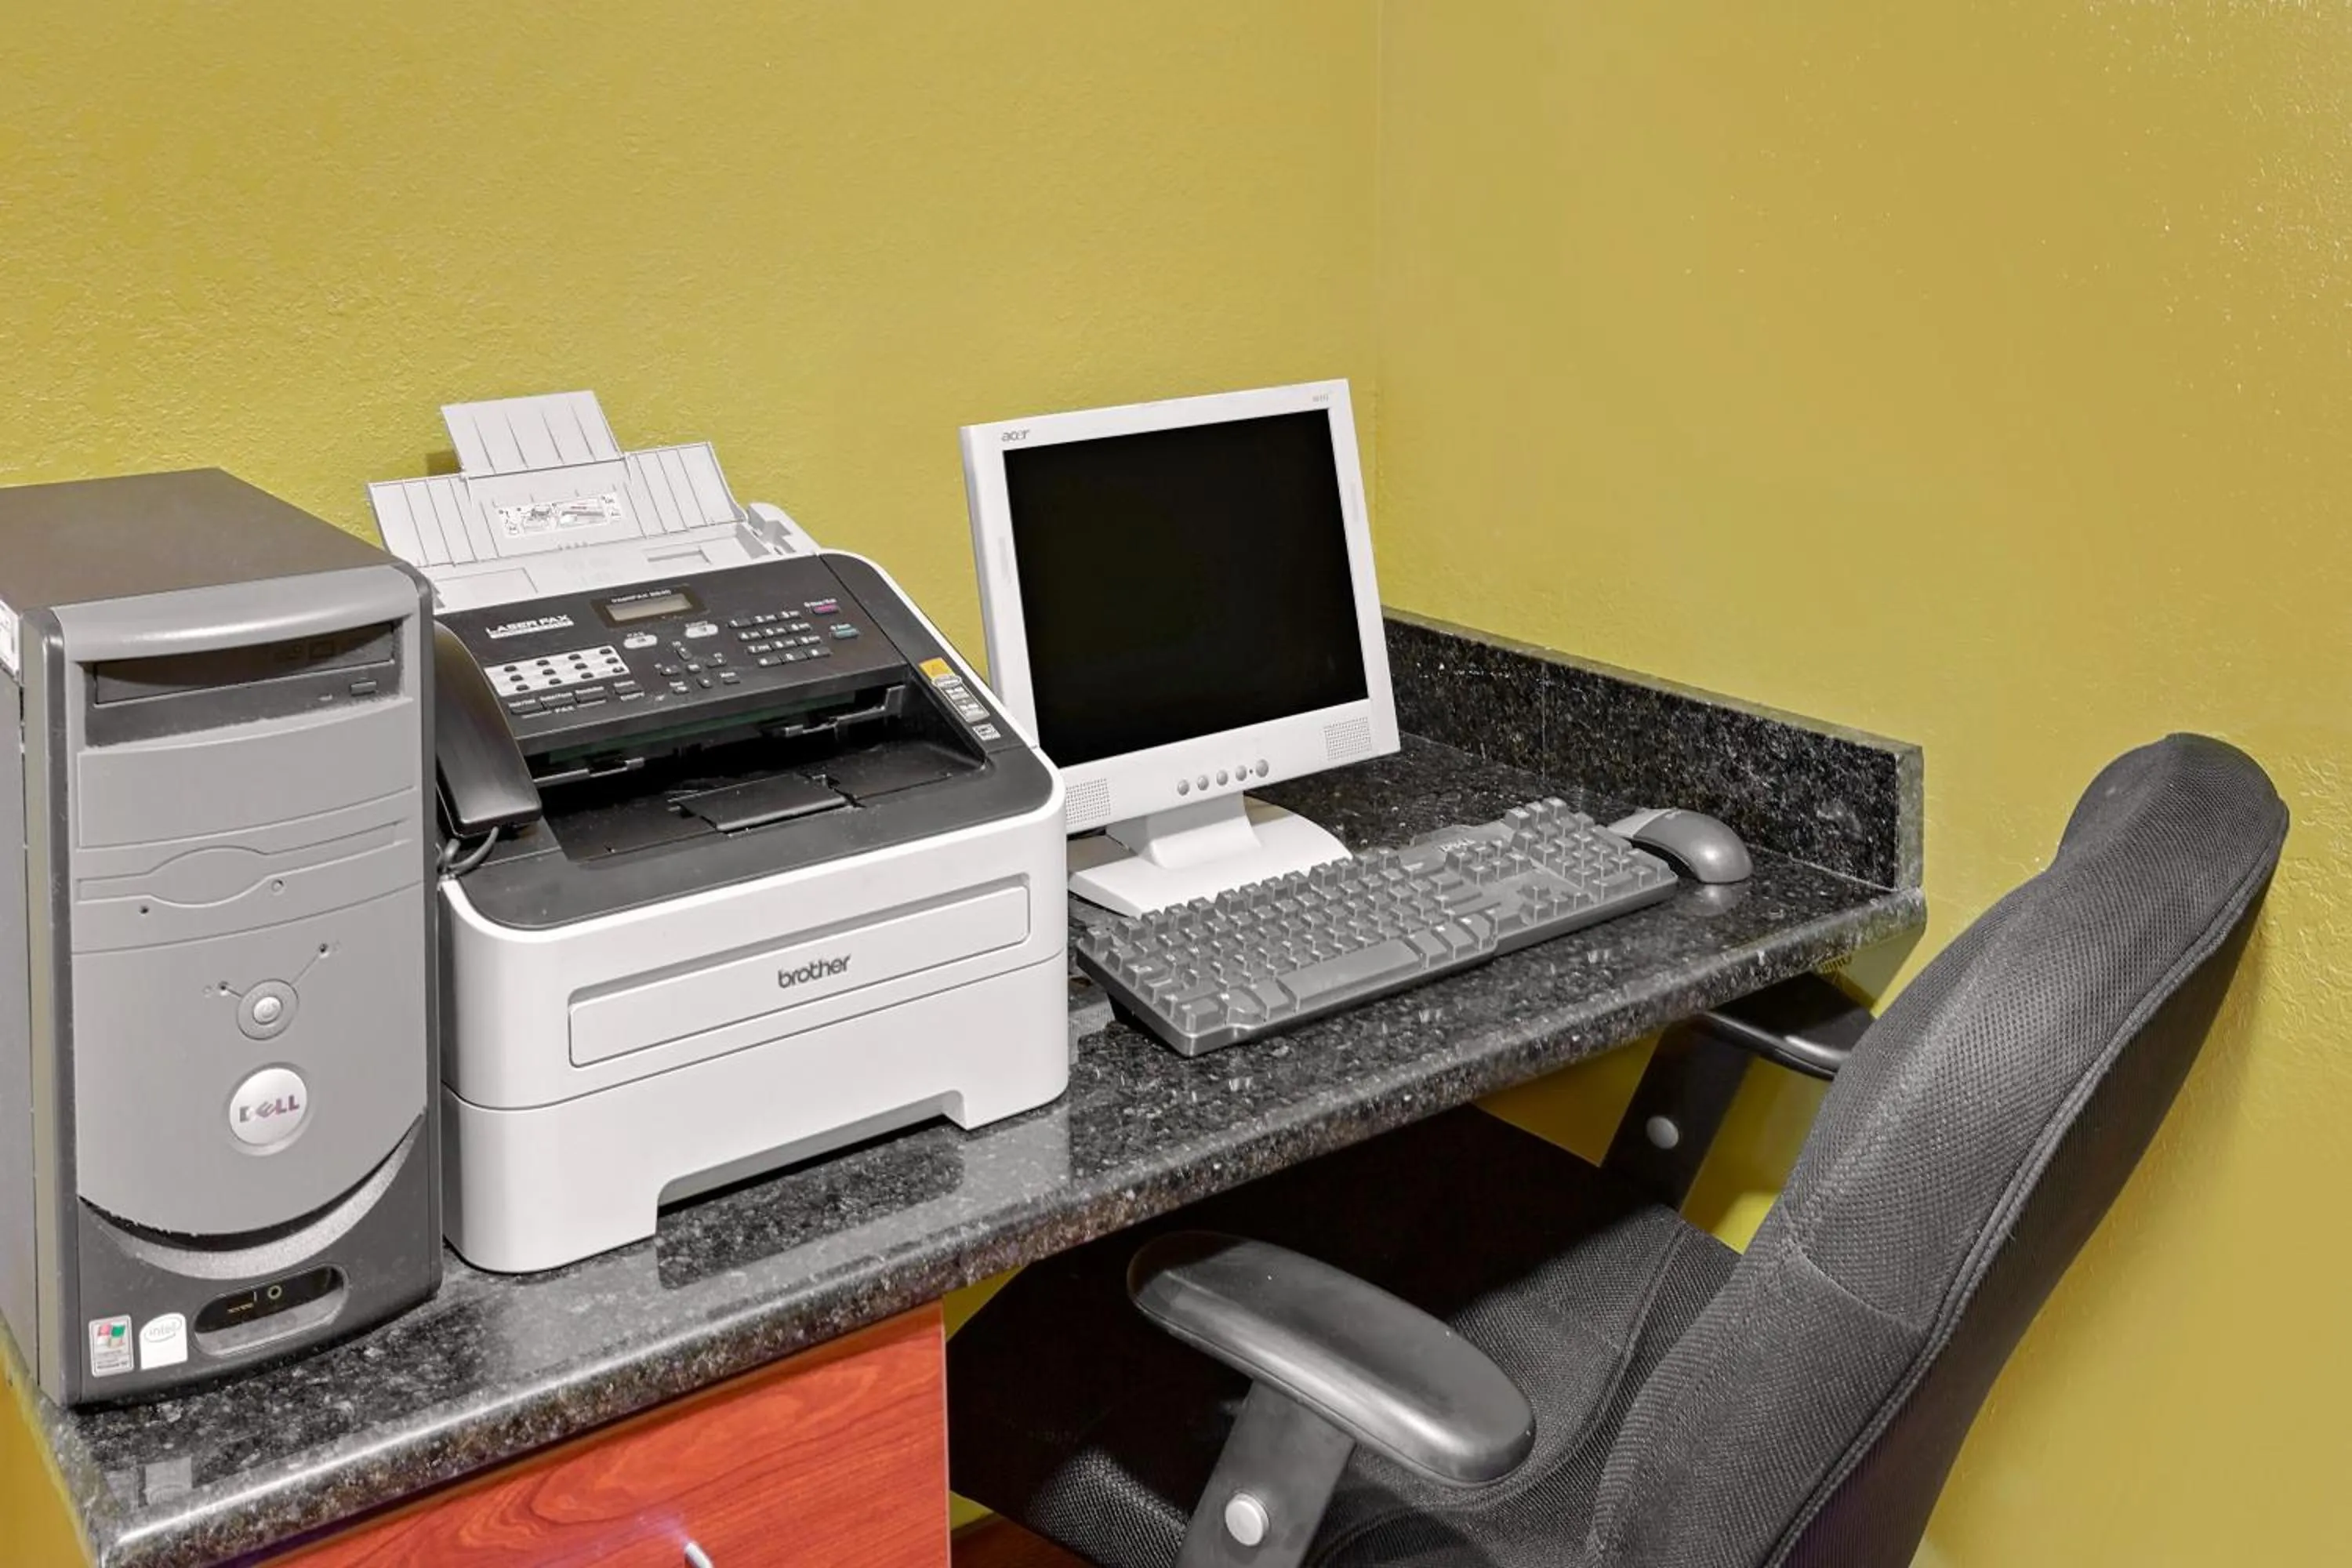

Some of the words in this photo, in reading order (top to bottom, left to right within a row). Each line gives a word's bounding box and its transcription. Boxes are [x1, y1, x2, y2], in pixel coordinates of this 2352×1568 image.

[1001, 429, 1030, 442] acer
[485, 619, 539, 636] LASER
[539, 615, 572, 627] FAX
[778, 953, 851, 988] brother
[239, 1094, 300, 1123] DELL
